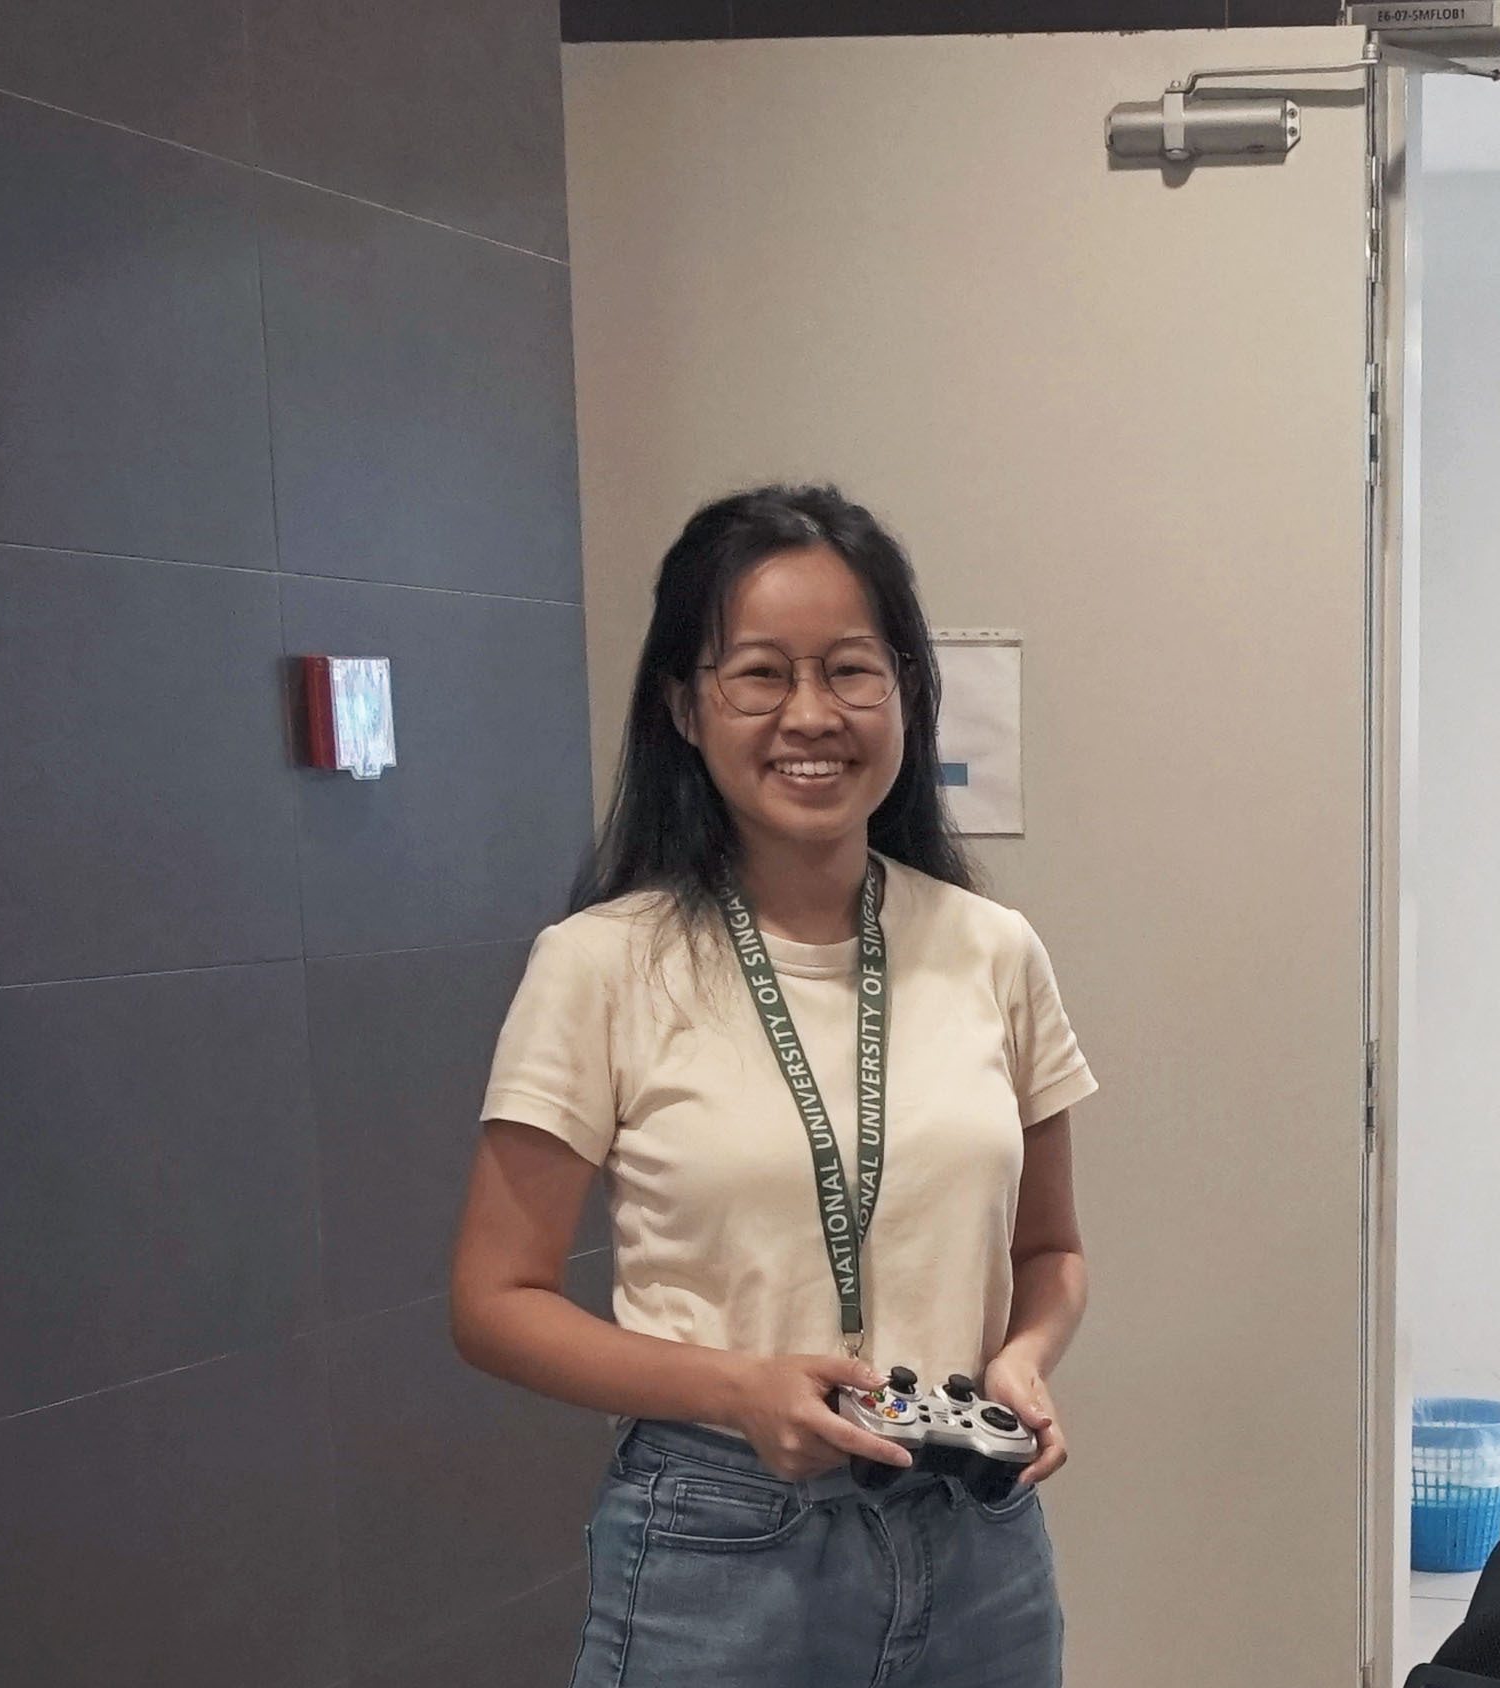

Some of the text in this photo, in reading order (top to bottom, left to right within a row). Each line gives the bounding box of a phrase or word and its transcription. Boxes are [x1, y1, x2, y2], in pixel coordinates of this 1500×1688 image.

[751, 974, 779, 1005] OF
[862, 964, 883, 996] OF
[765, 1014, 833, 1150] UNIVERSITY
[860, 1003, 882, 1146] UNIVERSITY
[819, 1158, 856, 1295] NATIONAL
